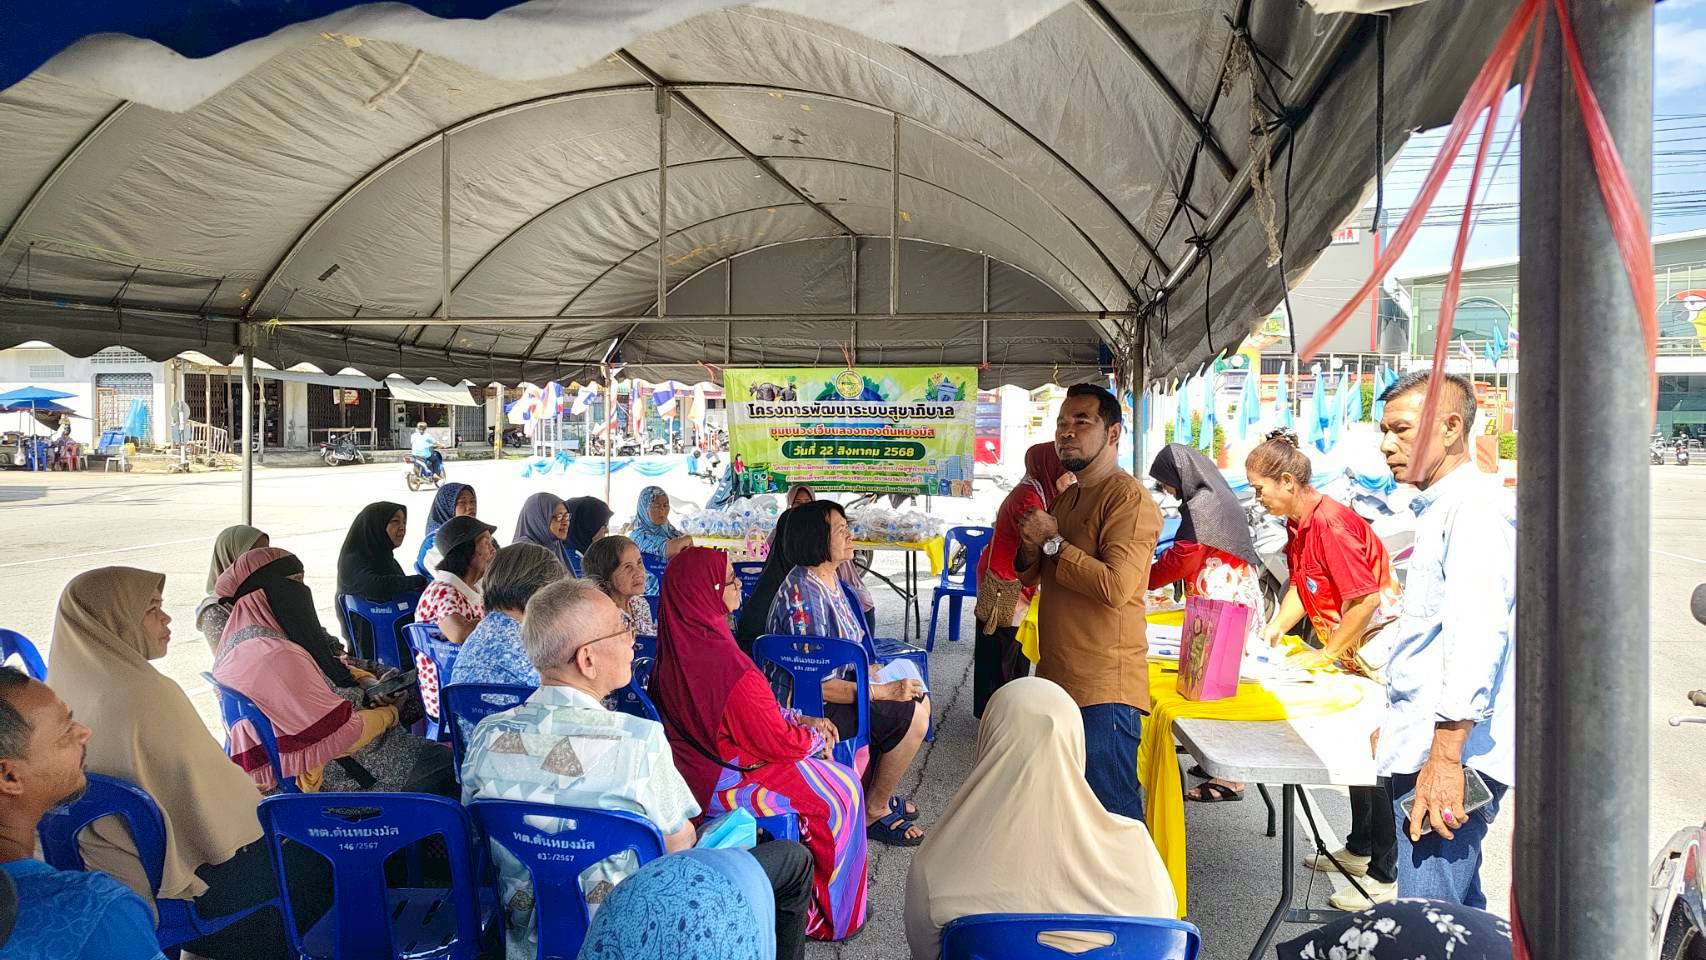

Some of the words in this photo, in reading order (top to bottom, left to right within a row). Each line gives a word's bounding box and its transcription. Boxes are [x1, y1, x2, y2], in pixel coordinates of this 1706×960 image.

[748, 403, 954, 422] โครงการพัฒนาระบบสุขาภิบาล
[793, 444, 816, 456] วันที่
[820, 446, 833, 455] 22
[838, 445, 880, 457] สิงหาคม
[884, 447, 915, 457] 2568
[308, 825, 399, 837] ทต.ตันหยงมัส
[513, 831, 595, 849] ทต.ตันหยงมัส
